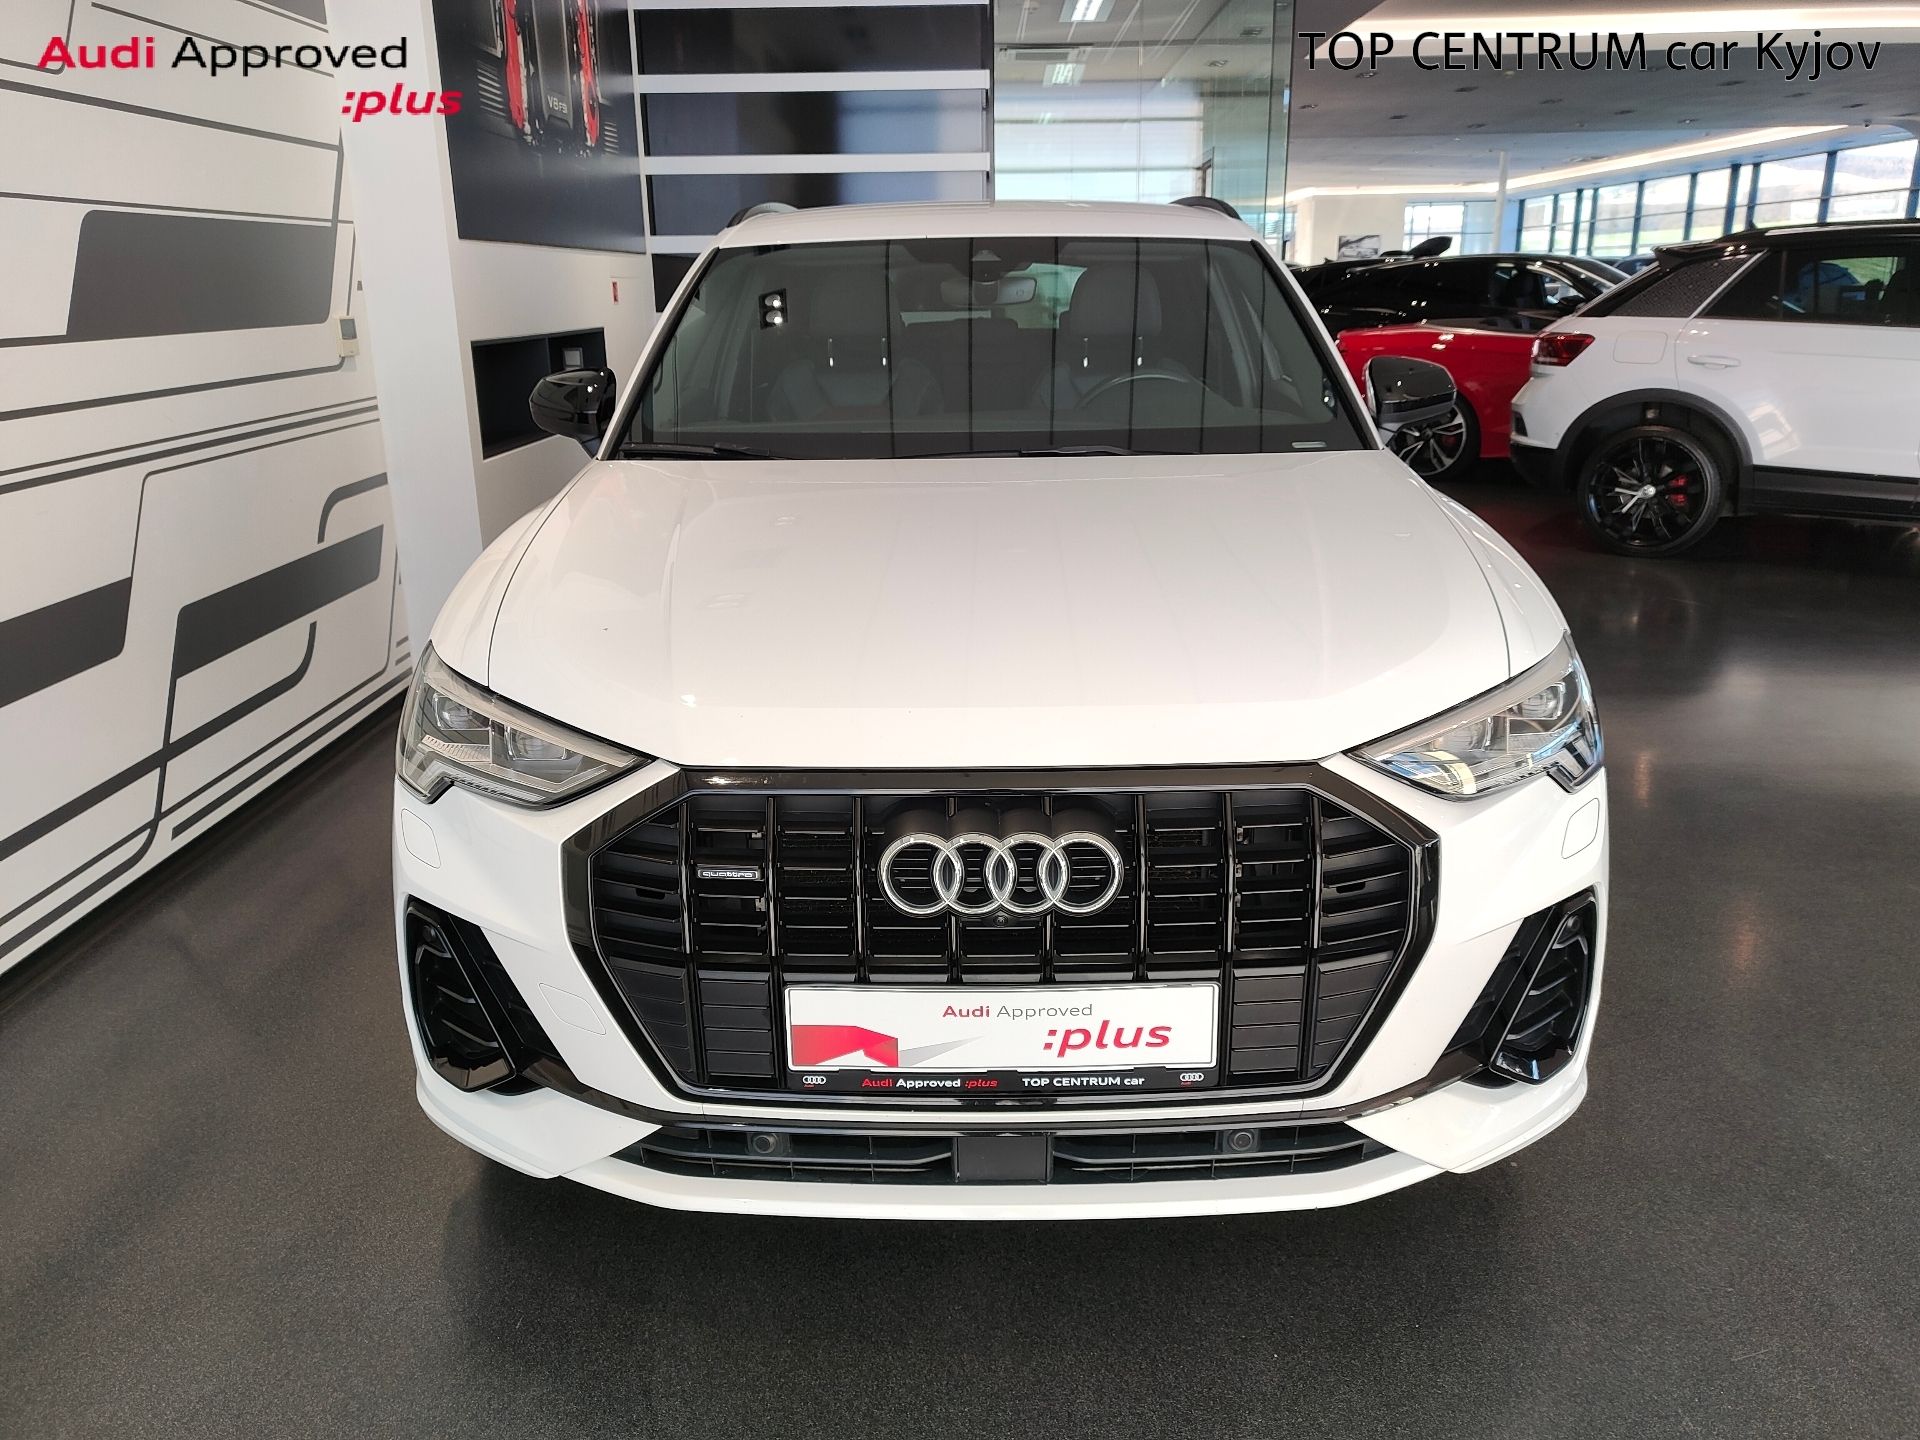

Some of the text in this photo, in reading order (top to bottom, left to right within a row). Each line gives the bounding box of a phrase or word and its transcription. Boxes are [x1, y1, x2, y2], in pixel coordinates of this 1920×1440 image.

[942, 1004, 1093, 1020] Audi Approved
[861, 1078, 893, 1088] Audi
[896, 1078, 961, 1089] Approved
[1022, 1077, 1050, 1087] TOP
[1053, 1076, 1121, 1087] CENTRUM
[1124, 1076, 1145, 1086] car
